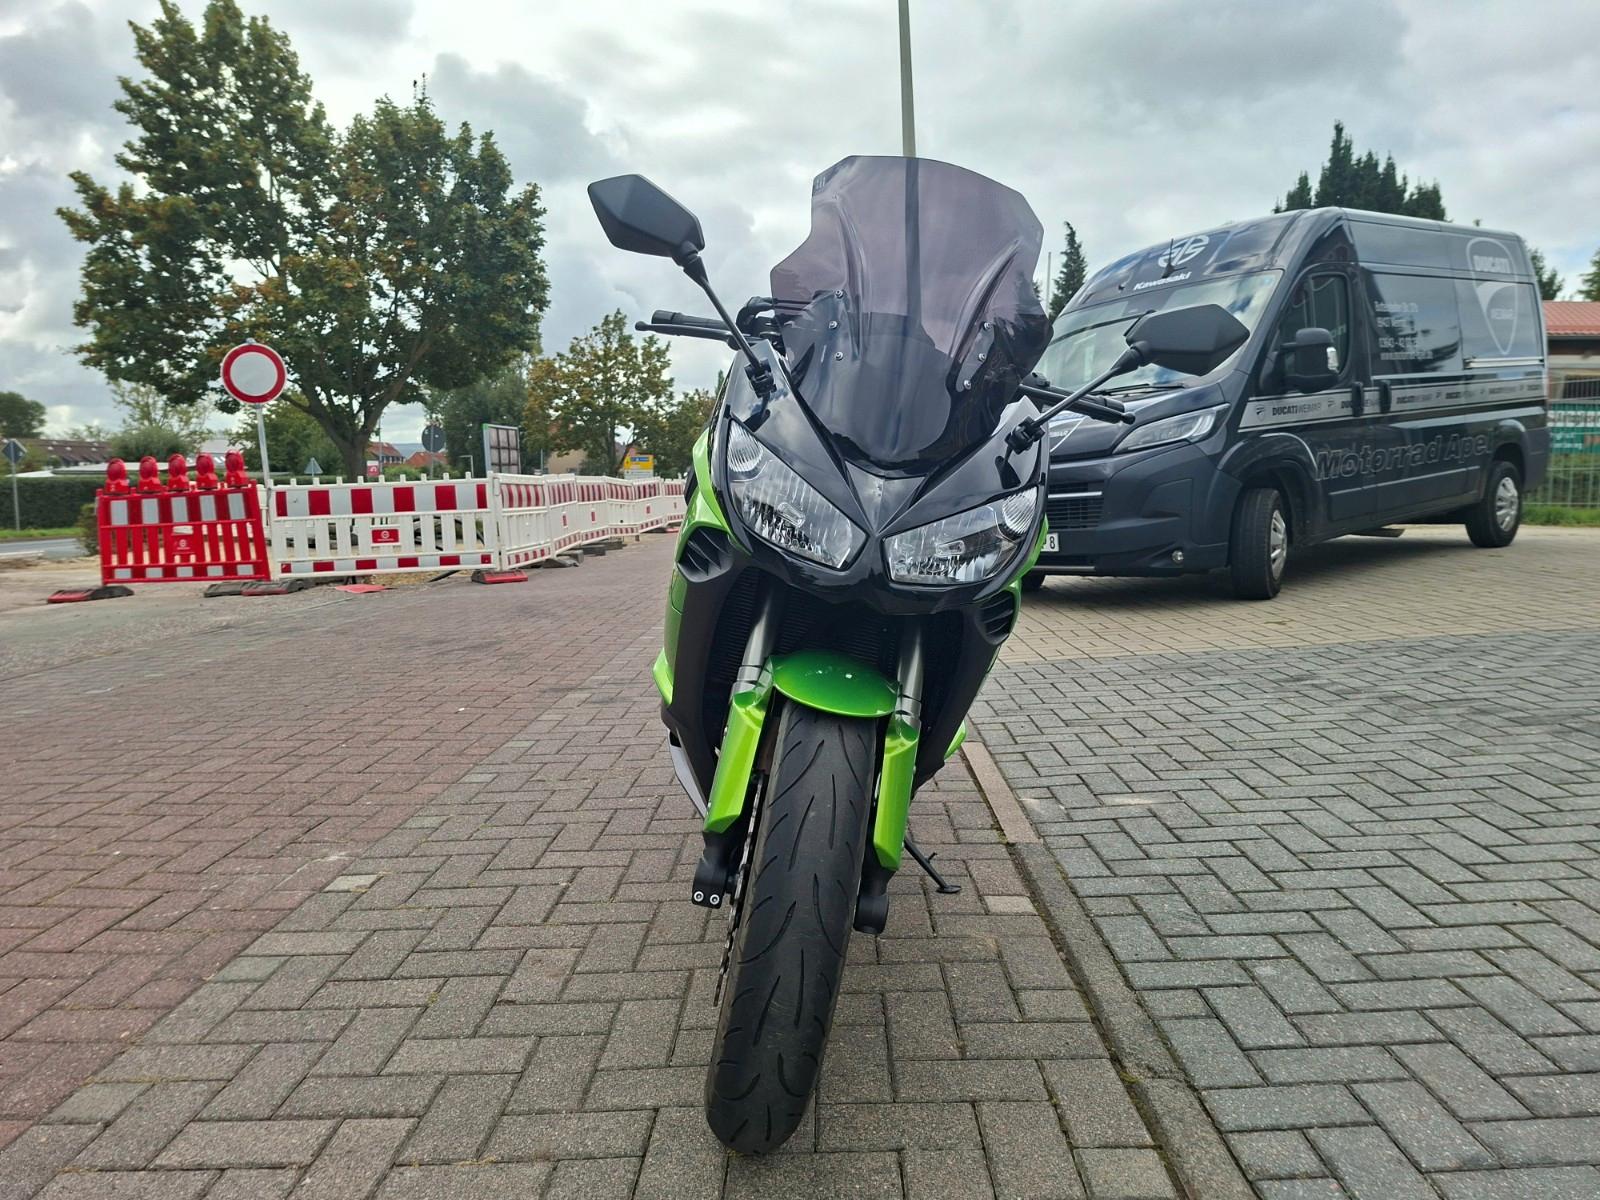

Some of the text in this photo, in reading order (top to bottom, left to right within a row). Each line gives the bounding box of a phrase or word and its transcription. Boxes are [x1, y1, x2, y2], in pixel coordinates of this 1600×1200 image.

[1472, 255, 1511, 274] DUCATI
[1133, 272, 1192, 290] Kawasaki
[1314, 434, 1443, 481] Motorrad
